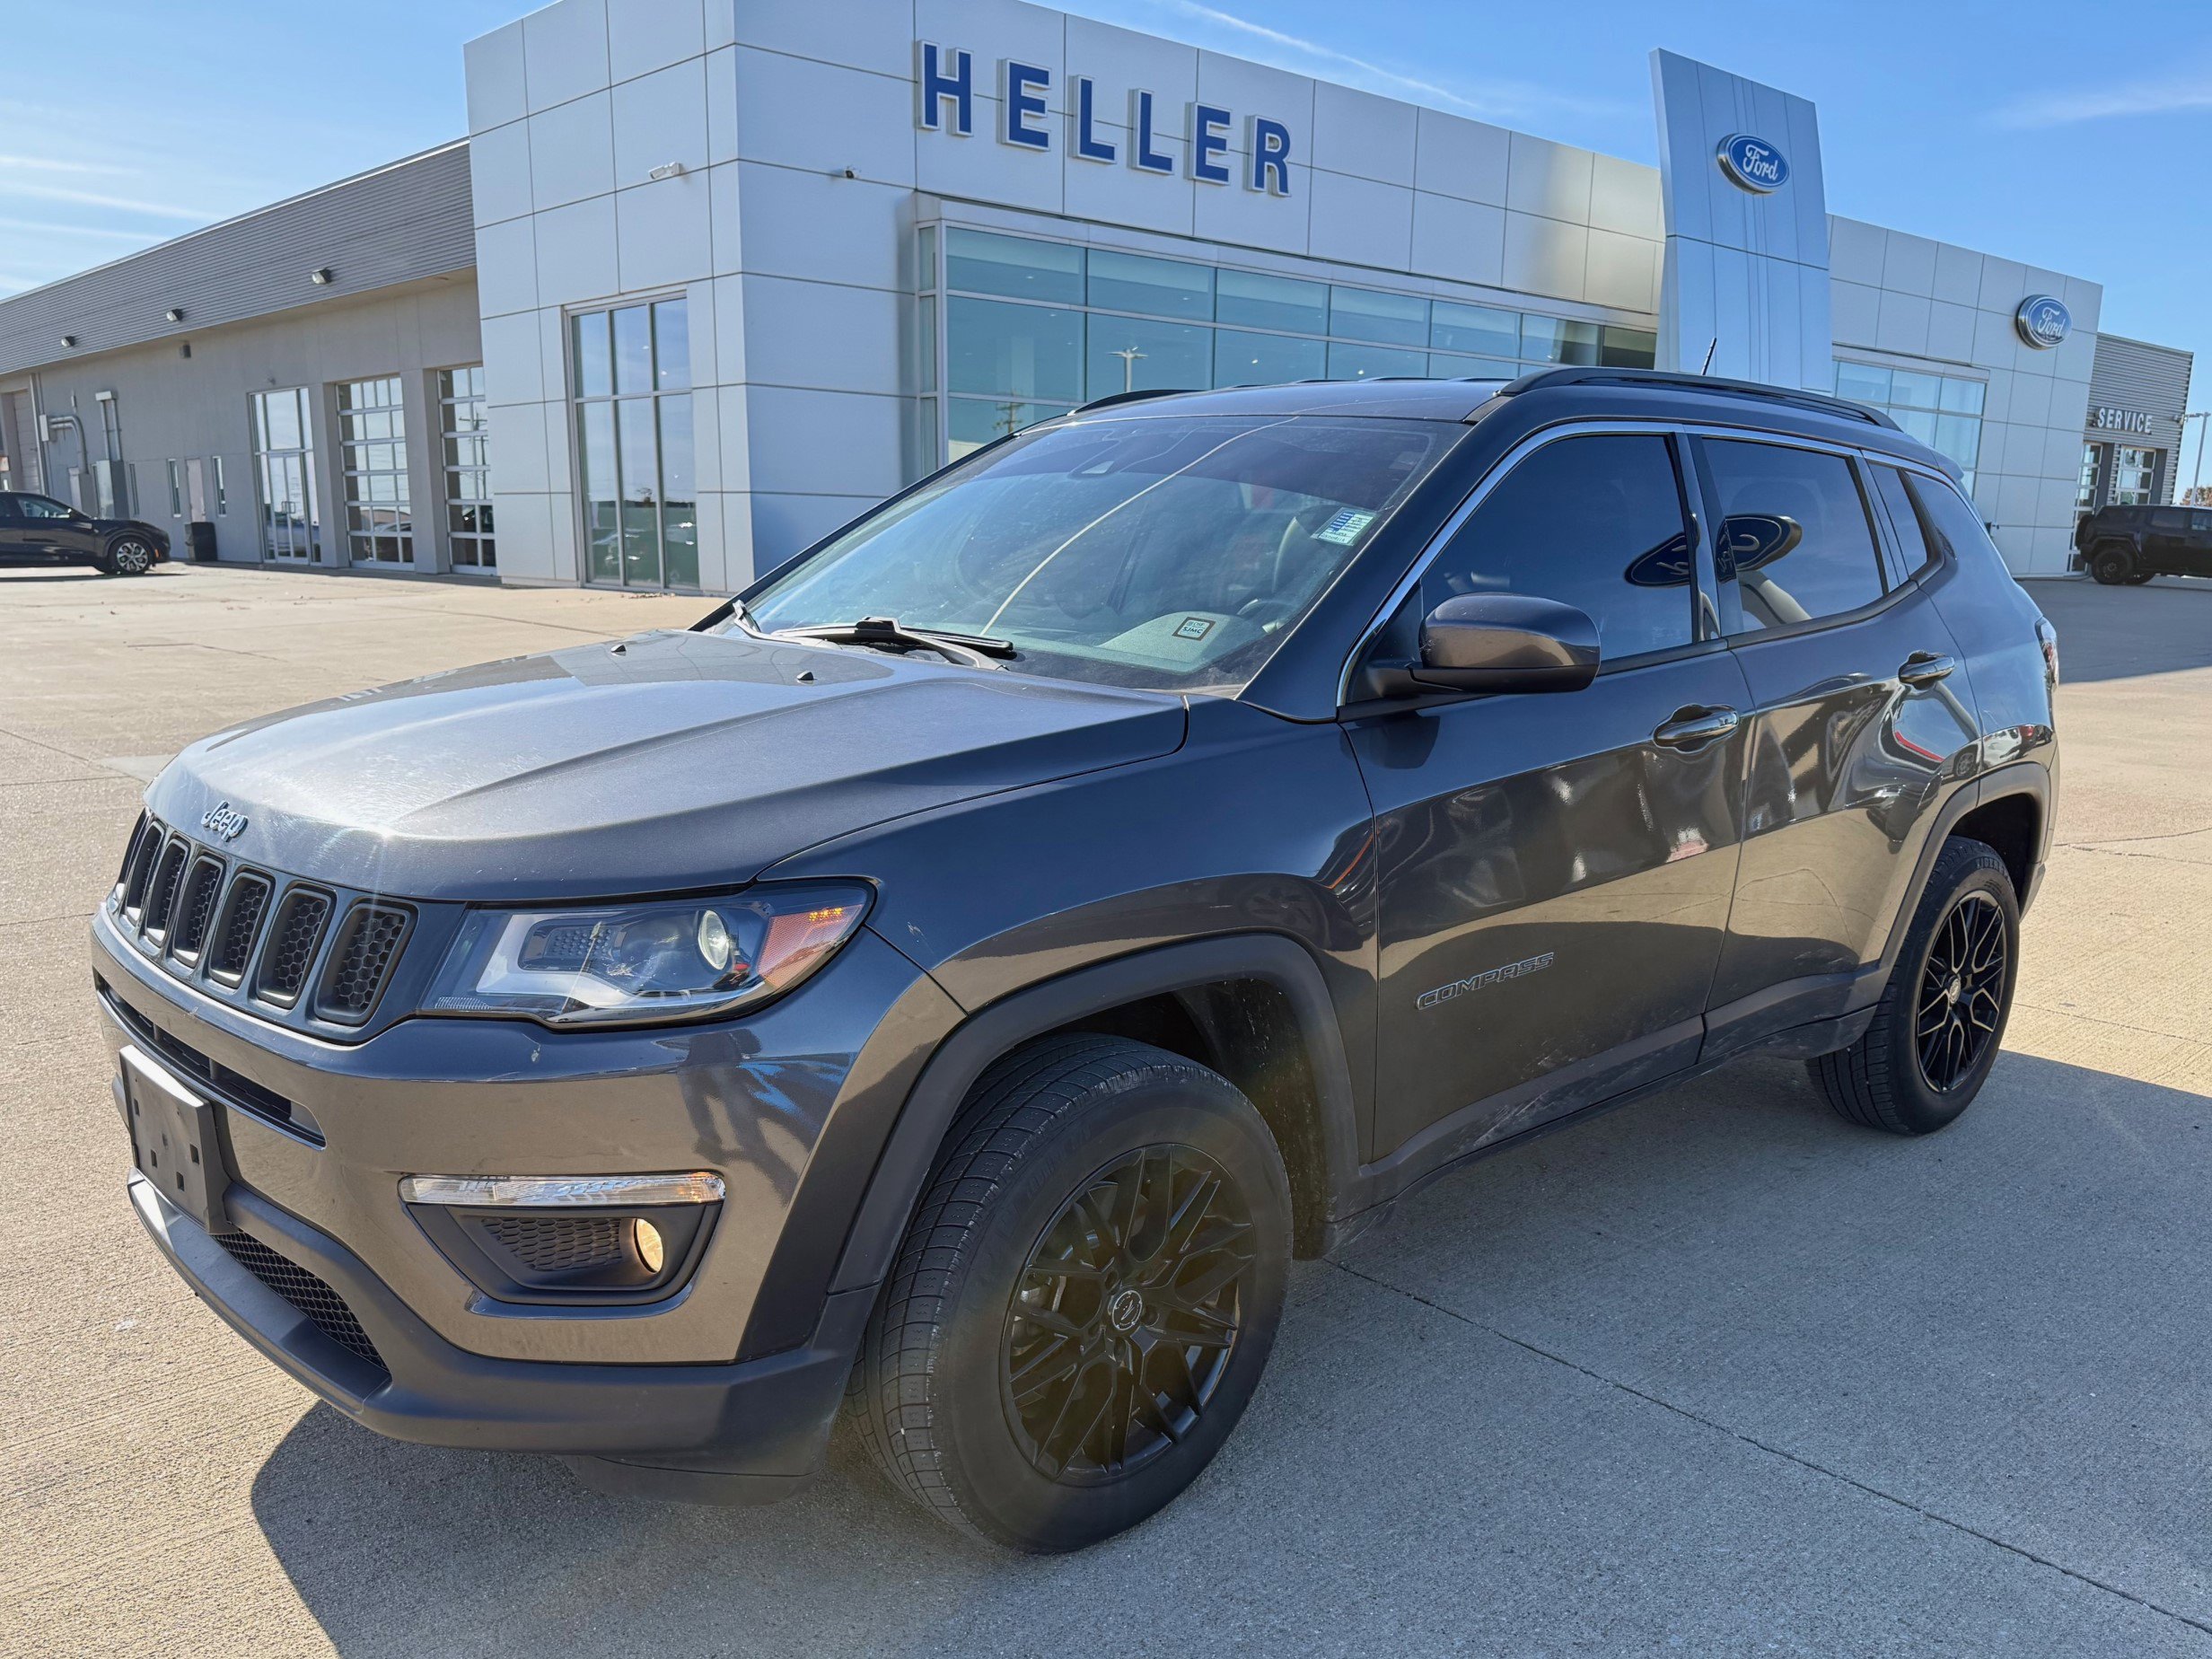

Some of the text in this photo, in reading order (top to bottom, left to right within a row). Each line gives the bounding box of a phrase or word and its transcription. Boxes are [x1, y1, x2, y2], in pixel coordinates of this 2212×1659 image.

[918, 40, 1291, 197] HELLER
[1742, 145, 1779, 180] Ford
[2037, 306, 2067, 338] Ford
[2096, 408, 2153, 434] SERVICE
[200, 800, 249, 842] Jeep
[1416, 952, 1554, 1010] COMPASS
